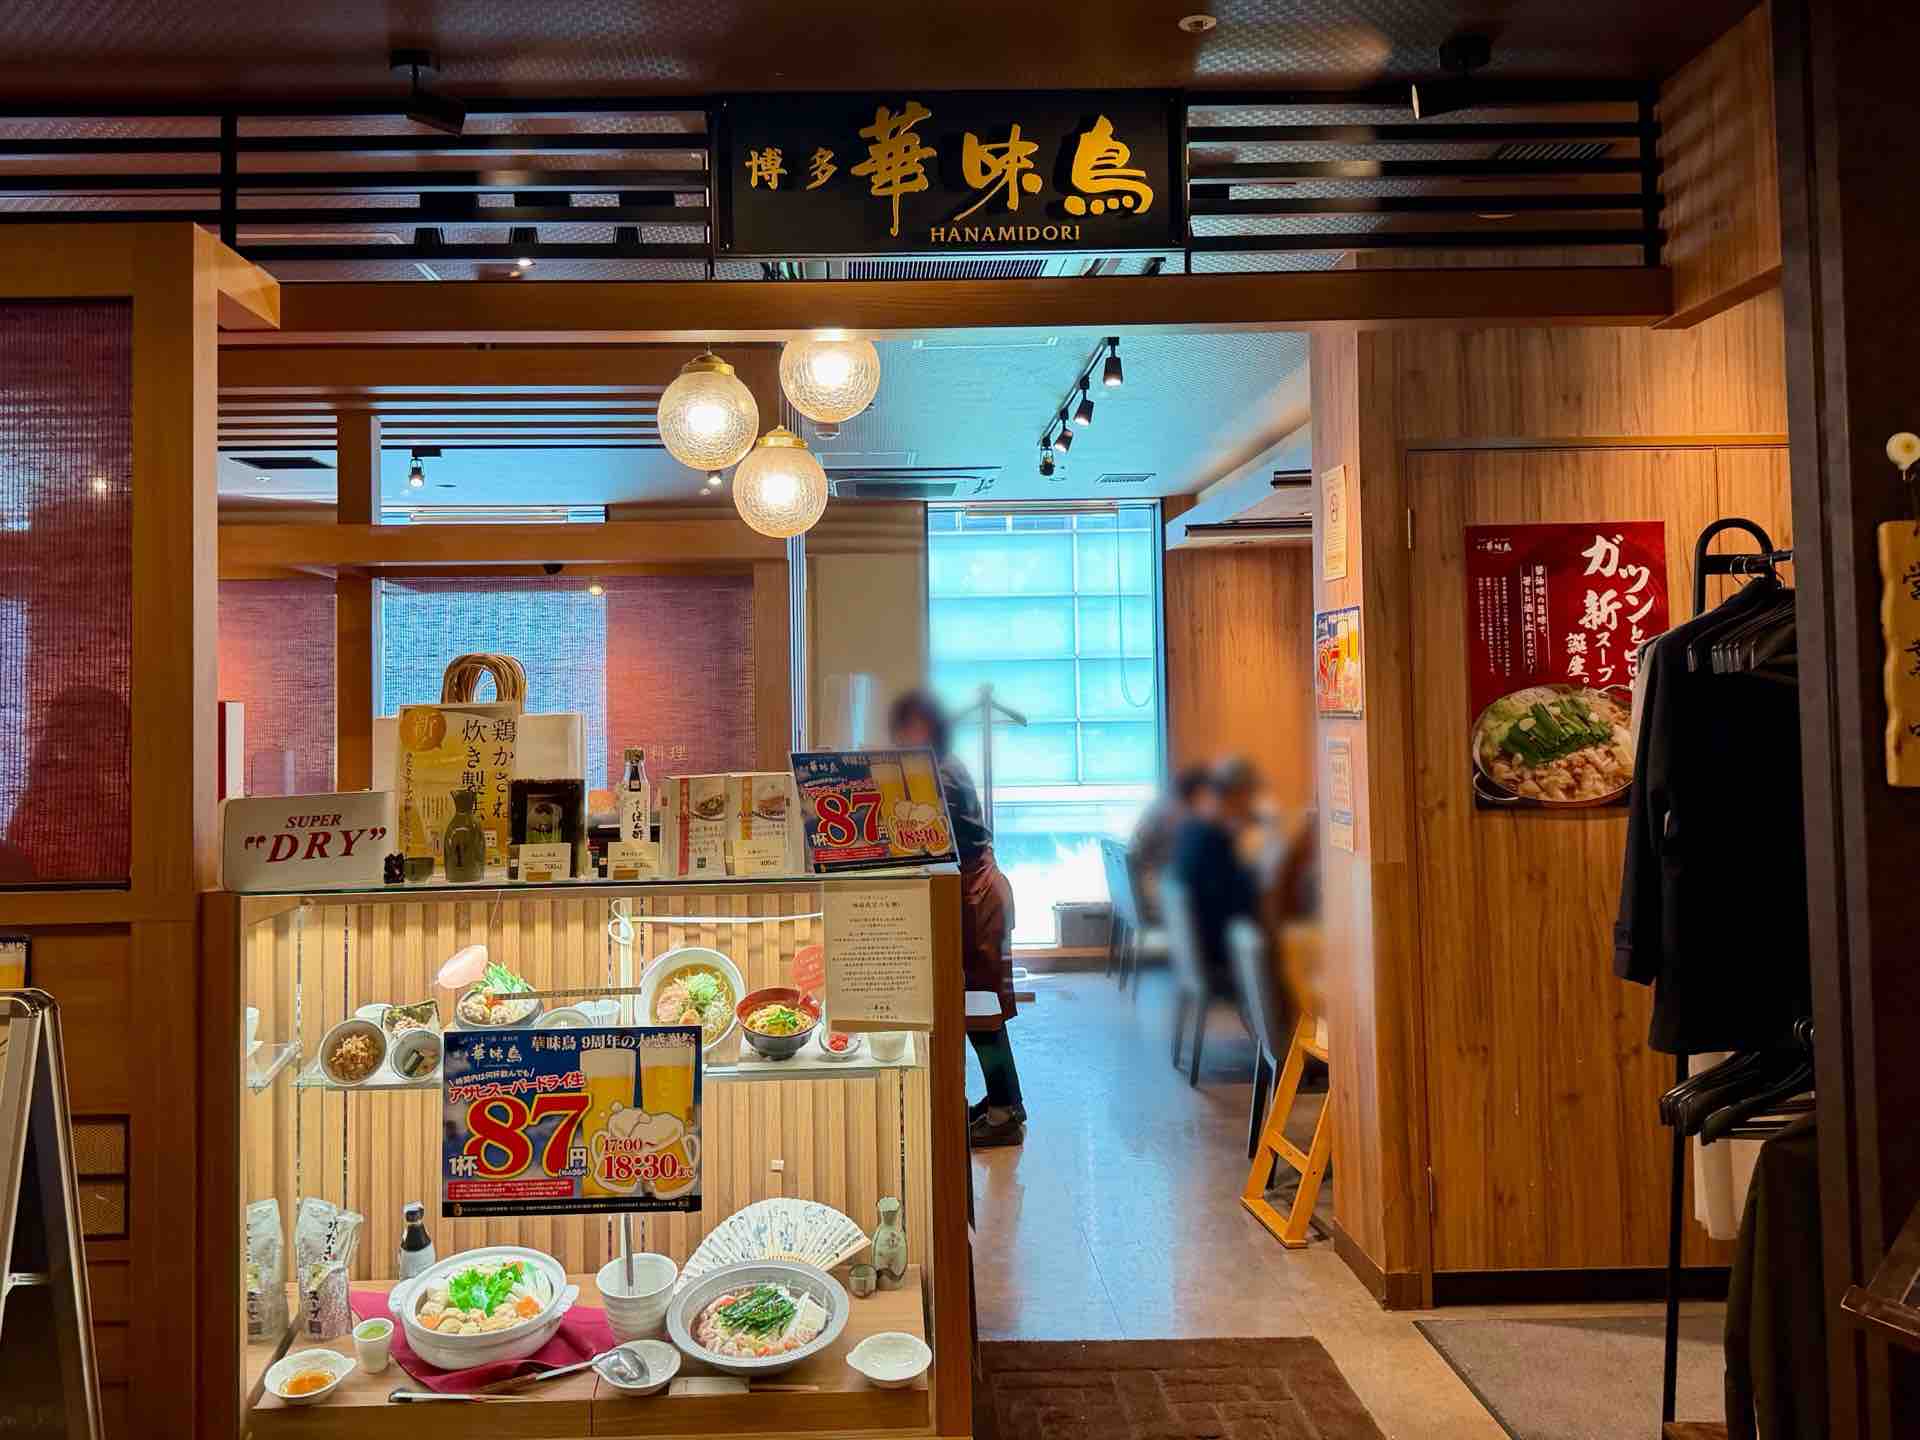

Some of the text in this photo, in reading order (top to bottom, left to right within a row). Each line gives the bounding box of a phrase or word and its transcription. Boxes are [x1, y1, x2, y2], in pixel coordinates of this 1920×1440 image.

[745, 101, 1154, 237] 博多 華味鳥
[931, 225, 1081, 243] HANAMIDORI
[285, 814, 343, 829] SUPER
[815, 792, 882, 847] 87
[471, 1043, 523, 1067] 華味鳥
[464, 1094, 593, 1180] 87
